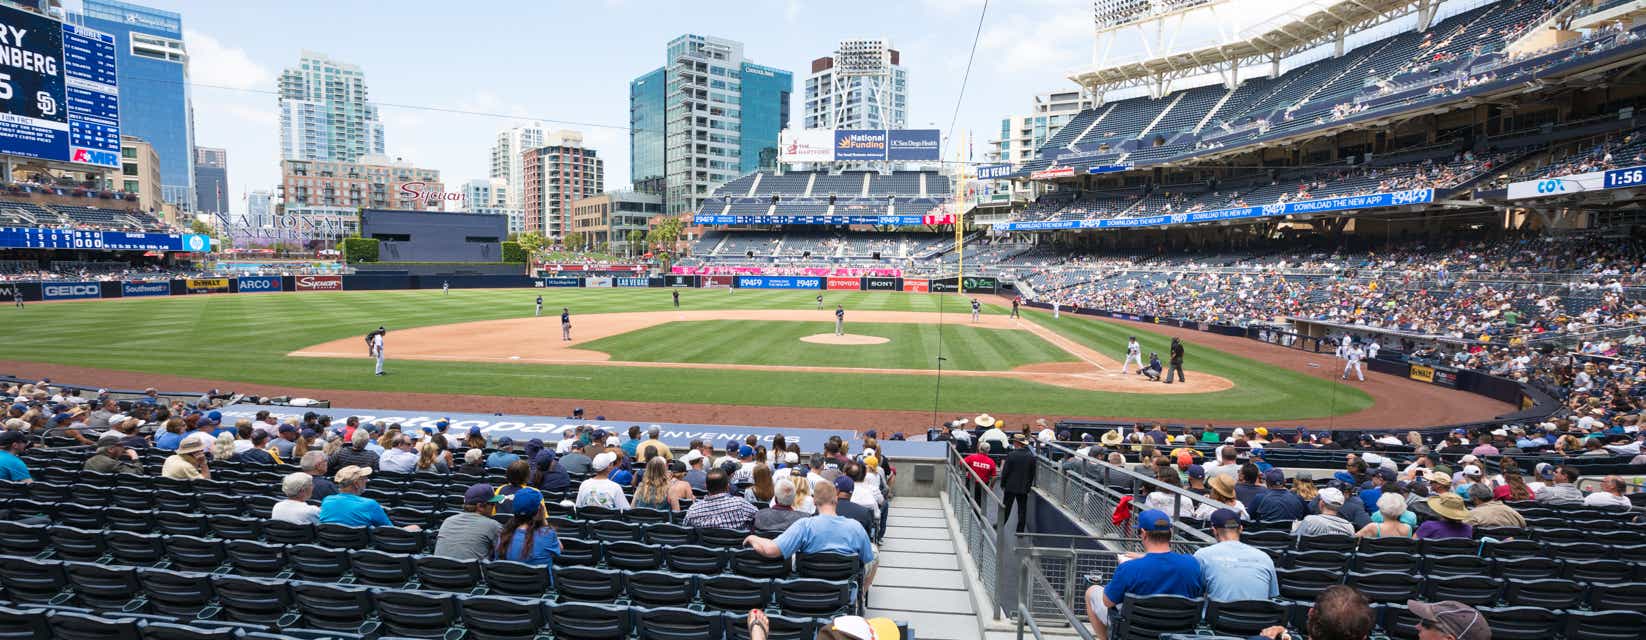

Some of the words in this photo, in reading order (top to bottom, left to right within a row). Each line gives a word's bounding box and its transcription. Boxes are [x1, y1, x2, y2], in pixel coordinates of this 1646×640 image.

[851, 133, 884, 143] National
[1610, 170, 1643, 186] 1:56
[401, 181, 466, 206] Sycuan
[1294, 202, 1332, 211] DOWNLOAD
[1333, 199, 1347, 207] THE
[1348, 197, 1366, 206] NEW
[1367, 196, 1382, 204] APP
[240, 279, 271, 289] ARCO
[301, 277, 338, 289] Sycuan
[45, 284, 99, 297] GEICO
[973, 461, 990, 470] ELITE
